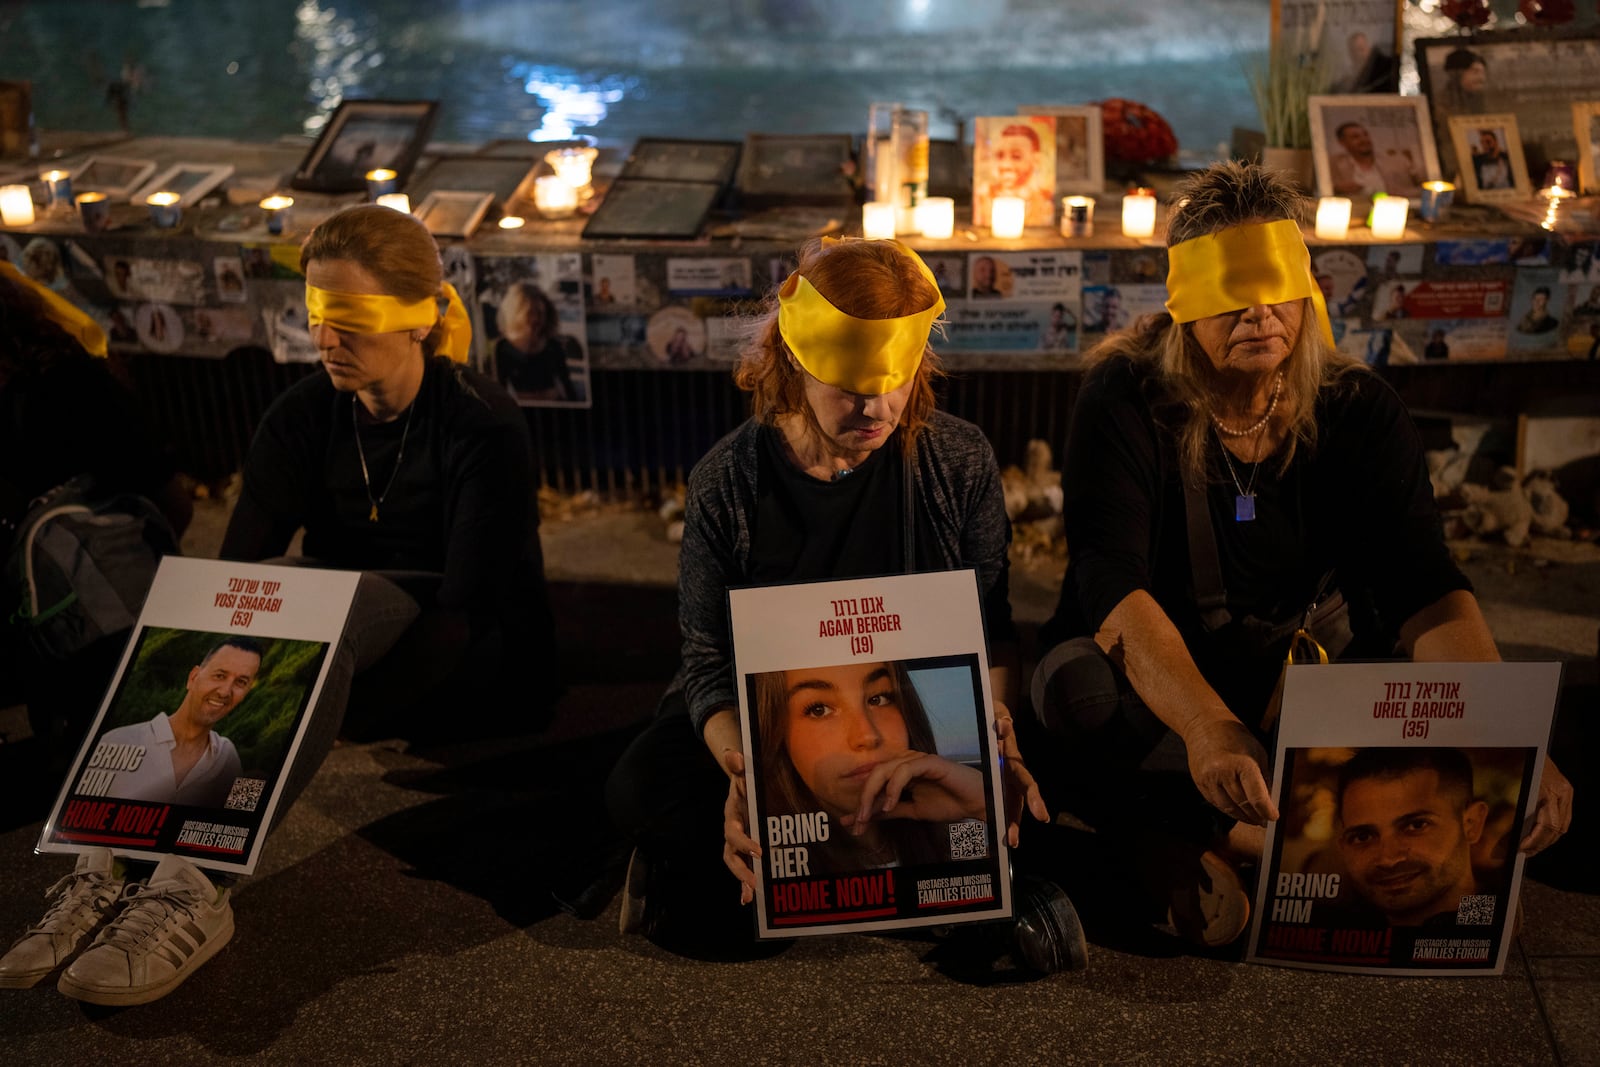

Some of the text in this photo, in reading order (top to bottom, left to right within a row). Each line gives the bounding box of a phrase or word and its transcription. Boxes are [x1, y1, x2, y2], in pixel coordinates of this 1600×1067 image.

[229, 577, 281, 596] יוסי שרעבי
[214, 592, 283, 612] YOSI SHARABI
[831, 596, 885, 617] אגם ברגר
[230, 610, 254, 628] (53)
[820, 614, 901, 638] AGAM BERGER
[851, 634, 873, 656] (19)
[1384, 681, 1461, 701] אוריאל ברוך
[1373, 701, 1465, 719] URIEL BARUCH
[1402, 720, 1429, 739] (35)
[88, 743, 146, 772] BRING
[74, 770, 116, 797] HIM
[61, 799, 171, 837] HOME NOW!
[183, 820, 250, 838] HOSTAGES AND MISSING
[767, 811, 830, 847] BRING
[176, 829, 247, 851] FAMILIES FORUM
[770, 846, 811, 879] HER
[773, 869, 896, 913] HOME NOW!
[917, 873, 992, 891] HOSTAGES AND MISSING
[1275, 871, 1341, 899] BRING
[918, 883, 993, 905] FAMILIES FORUM
[1271, 898, 1313, 924] HIM
[1267, 926, 1327, 953] HOME
[1415, 938, 1491, 949] HOSTAGES AND MISSING
[1413, 947, 1490, 960] FAMILIES FORUM
